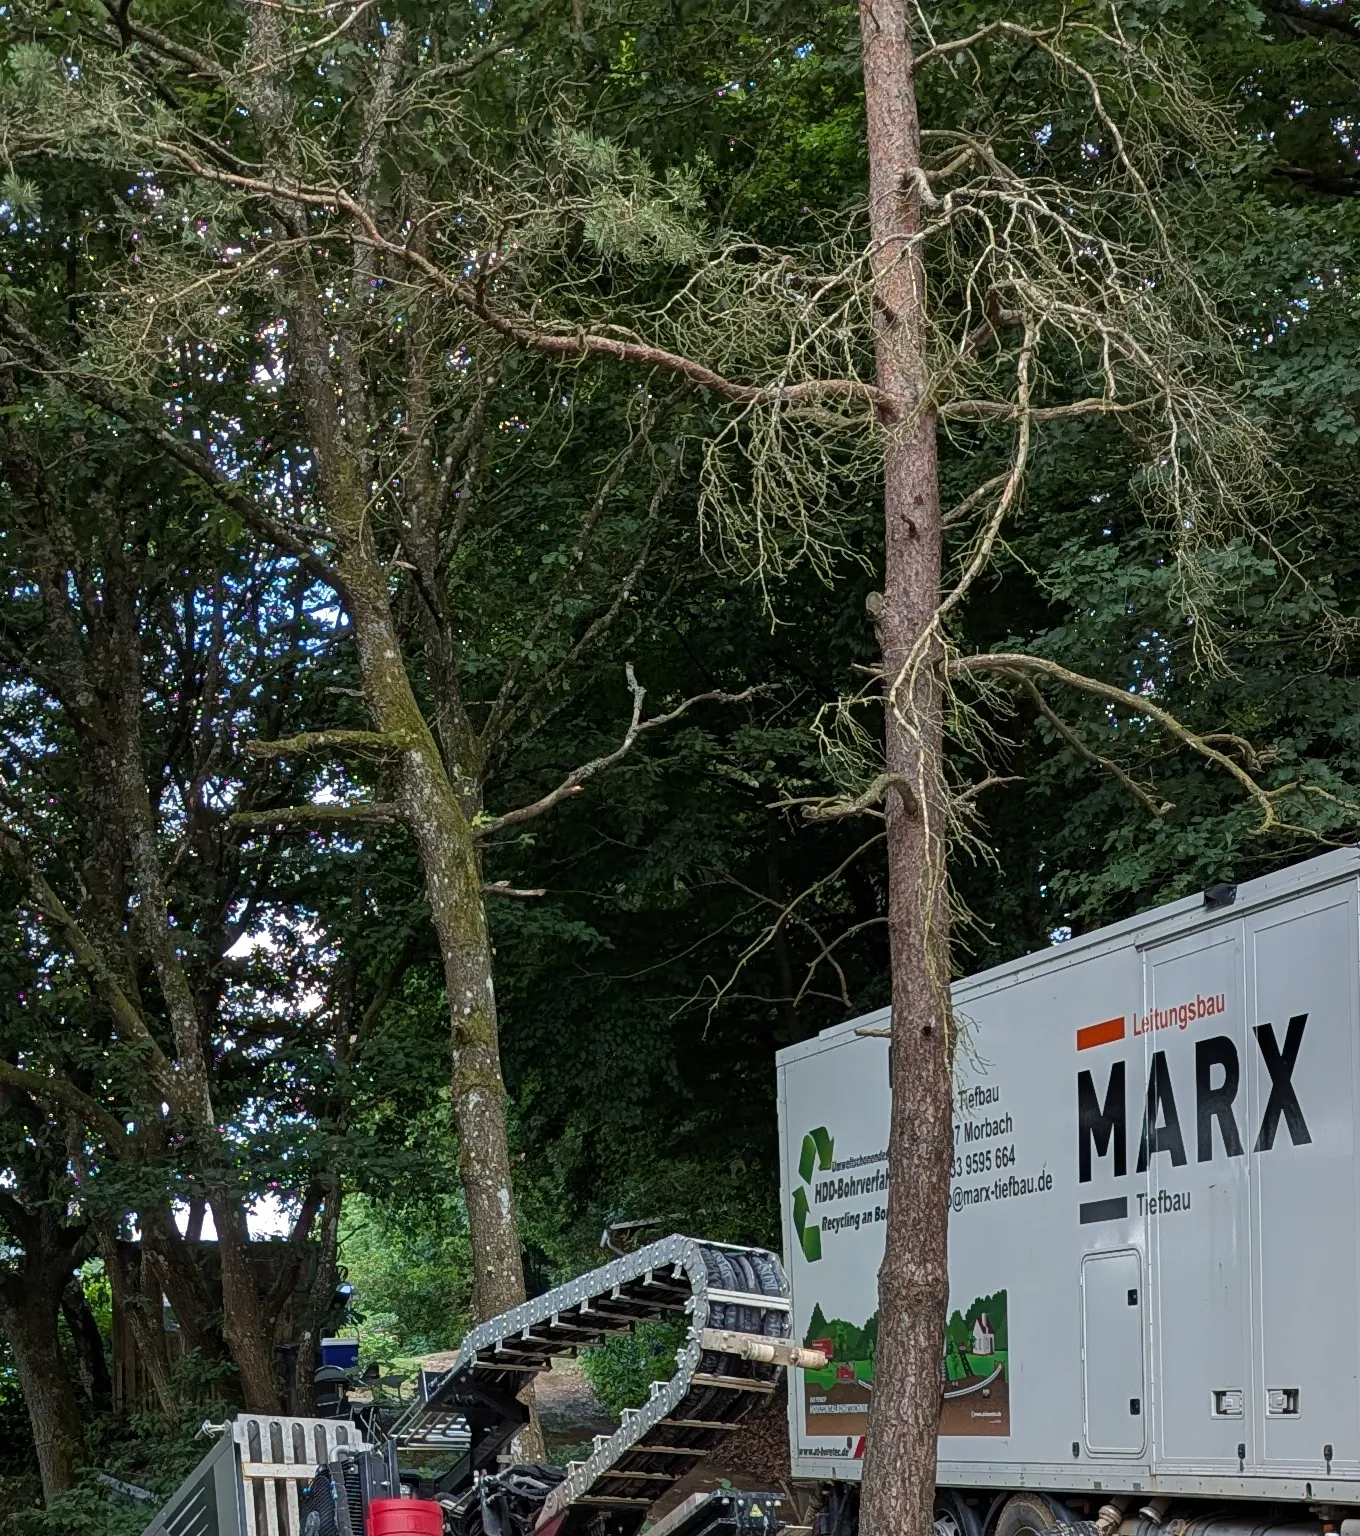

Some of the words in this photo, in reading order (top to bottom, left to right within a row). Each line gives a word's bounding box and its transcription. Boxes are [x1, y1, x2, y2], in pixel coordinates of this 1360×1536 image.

[1133, 993, 1226, 1036] Leitungsbau
[958, 1085, 1000, 1111] Tiefbau
[1077, 1012, 1313, 1184] MARX
[964, 1112, 1013, 1143] Morbach
[965, 1150, 992, 1175] 9595
[995, 1144, 1016, 1169] 664
[1136, 1189, 1191, 1217] Tiefbau
[821, 1211, 860, 1234] Recycling
[862, 1211, 873, 1225] an
